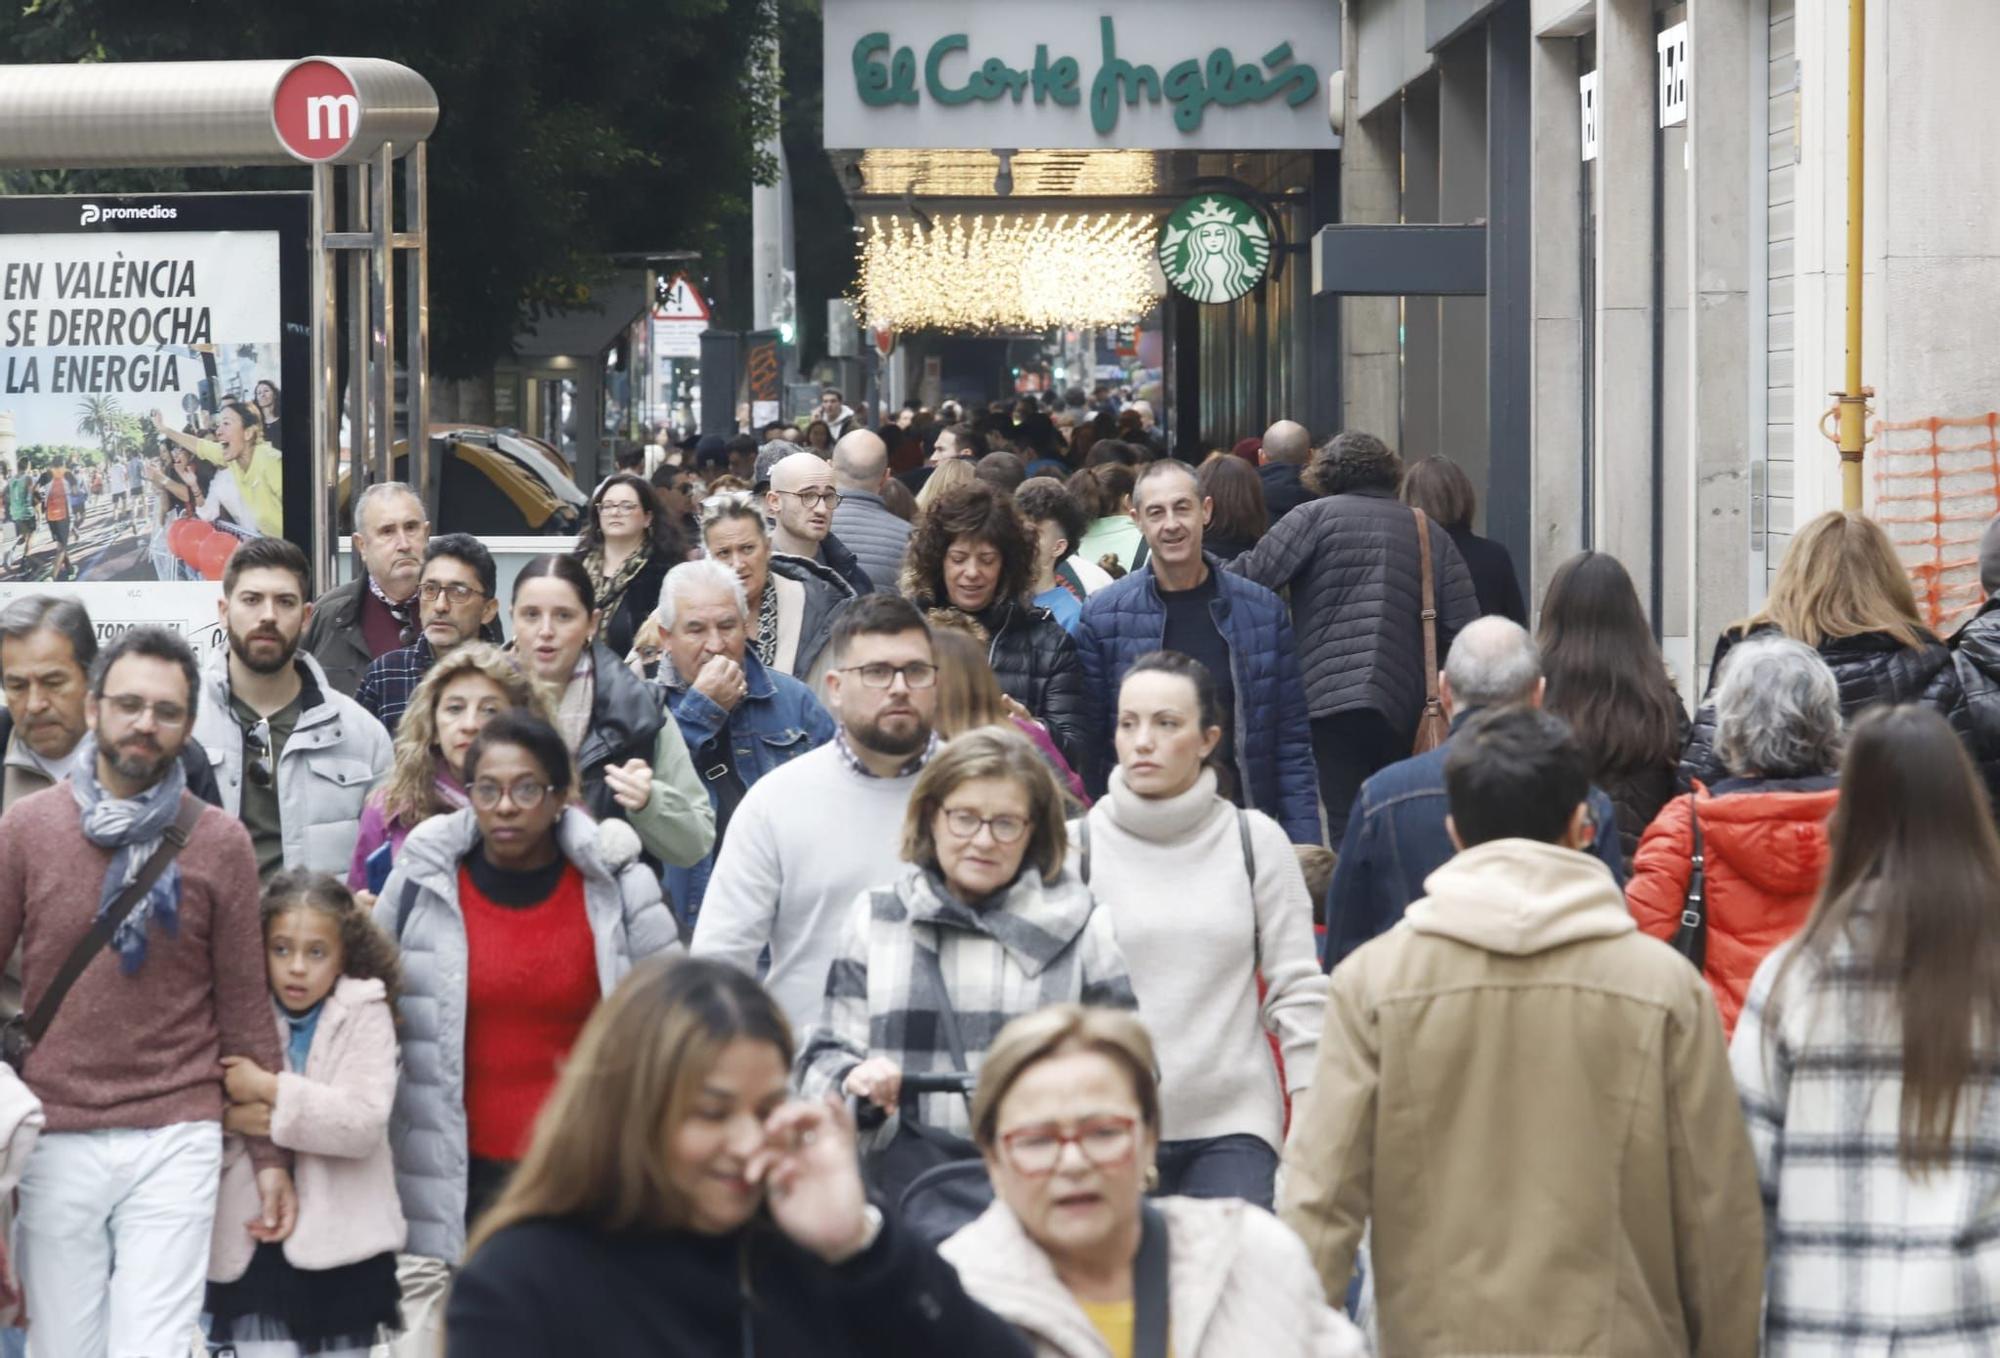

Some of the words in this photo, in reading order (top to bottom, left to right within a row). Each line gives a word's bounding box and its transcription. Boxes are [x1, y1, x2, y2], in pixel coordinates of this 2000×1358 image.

[851, 31, 920, 107] El
[924, 33, 1081, 107] Corte
[1090, 15, 1319, 135] Inglés
[306, 94, 359, 141] m
[102, 203, 178, 221] promedios
[3, 262, 42, 301] EN
[55, 251, 196, 299] VALÈNCIA
[5, 308, 37, 347] SE
[47, 306, 211, 347] DERROCHA
[5, 355, 39, 394] LA
[51, 343, 181, 394] ENERGÍA
